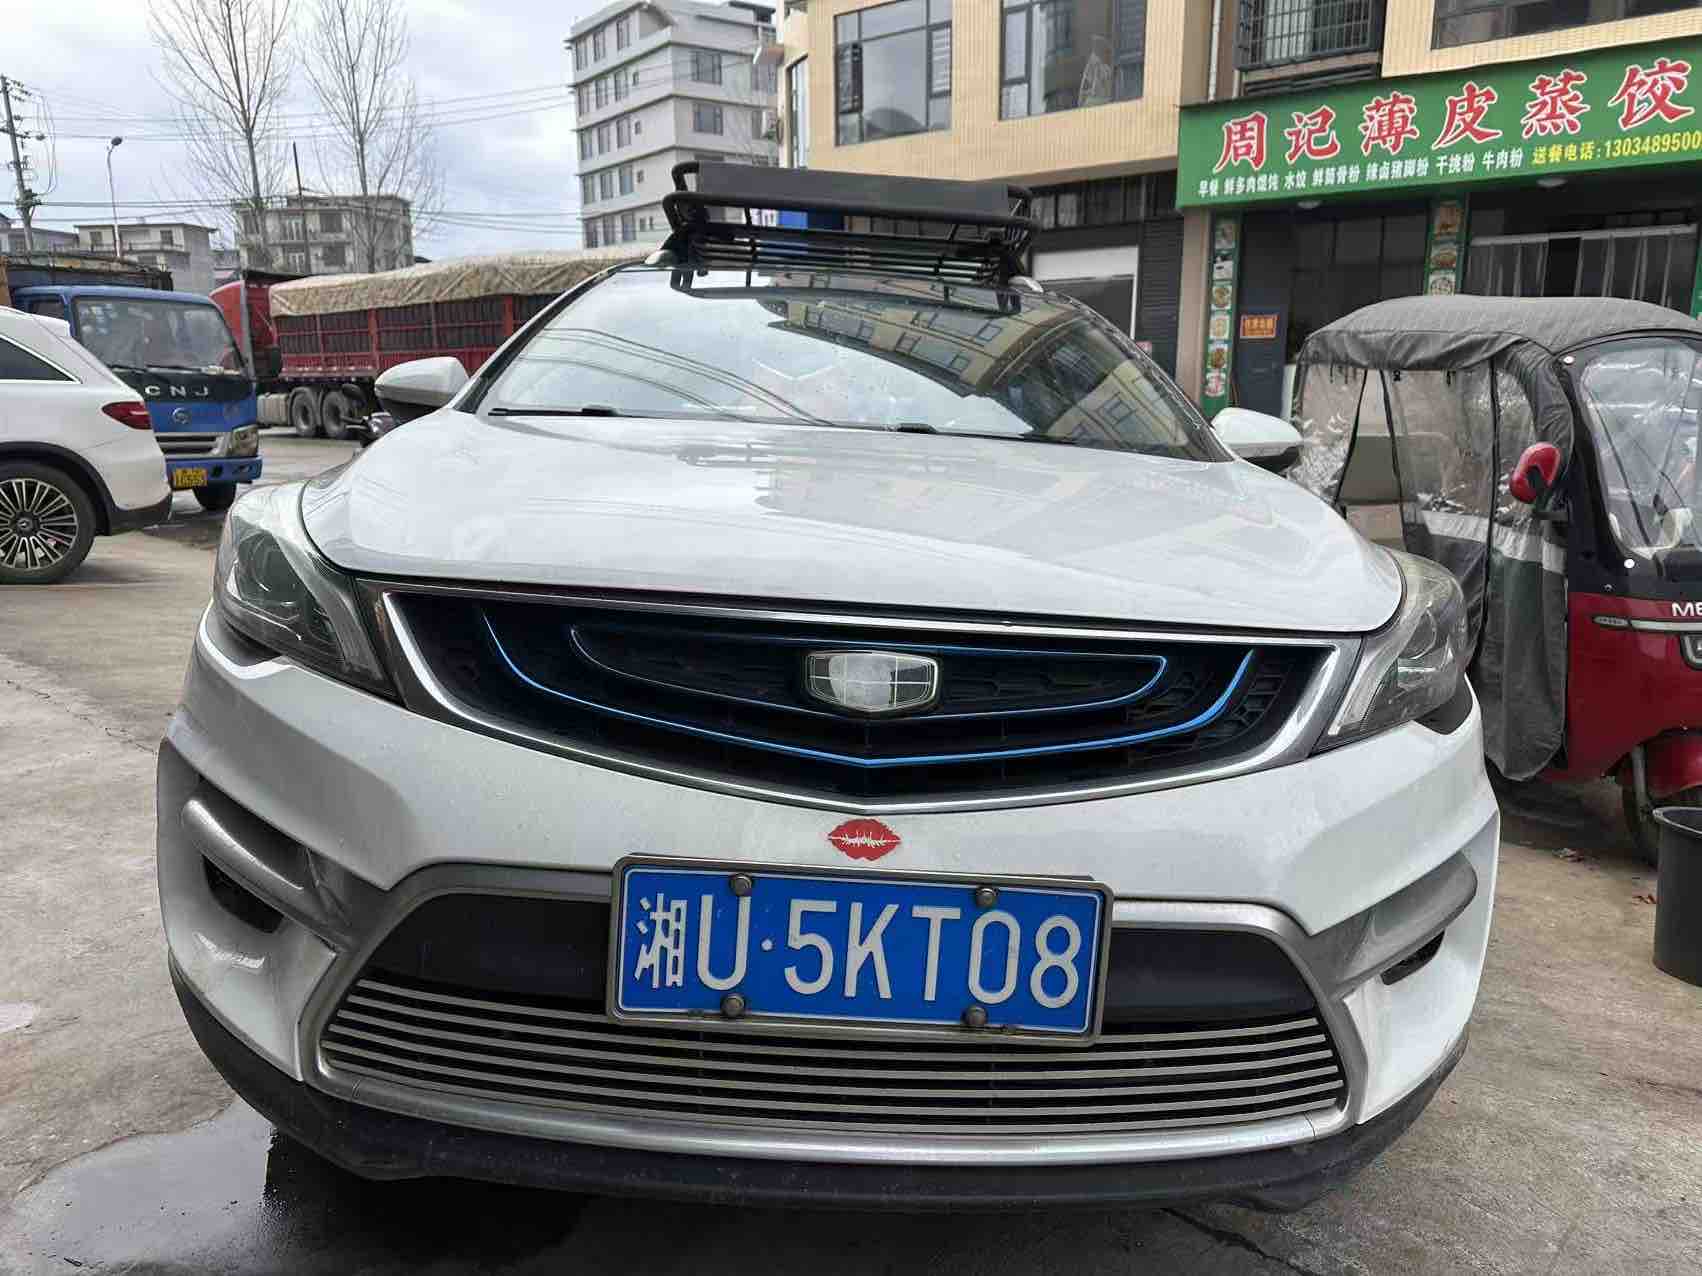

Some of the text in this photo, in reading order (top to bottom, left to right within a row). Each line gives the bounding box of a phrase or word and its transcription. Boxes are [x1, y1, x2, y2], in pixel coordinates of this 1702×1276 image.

[1212, 57, 1695, 174] 周记薄皮蒸饺
[1284, 168, 1307, 189] 水饺
[1482, 147, 1523, 171] 牛肉粉
[145, 385, 208, 397] CNJ
